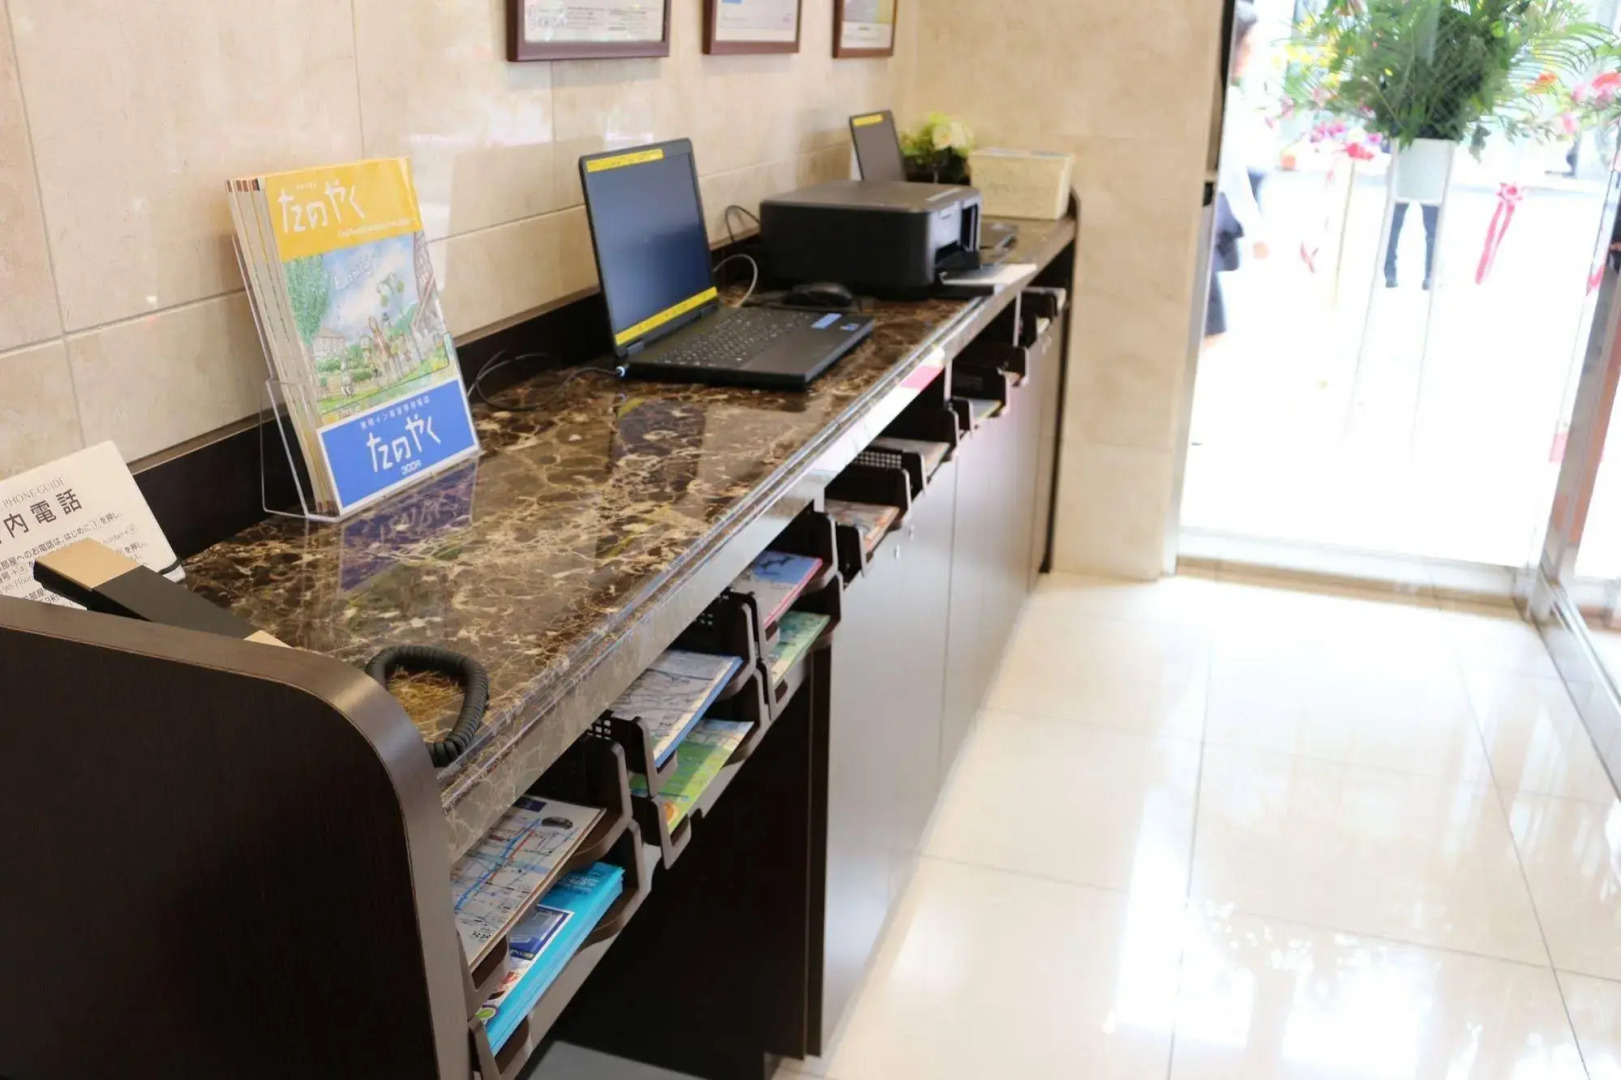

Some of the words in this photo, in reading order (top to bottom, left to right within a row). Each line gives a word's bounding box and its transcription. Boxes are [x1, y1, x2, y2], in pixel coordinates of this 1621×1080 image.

[278, 178, 365, 234] たのやく
[366, 413, 441, 473] たのやく
